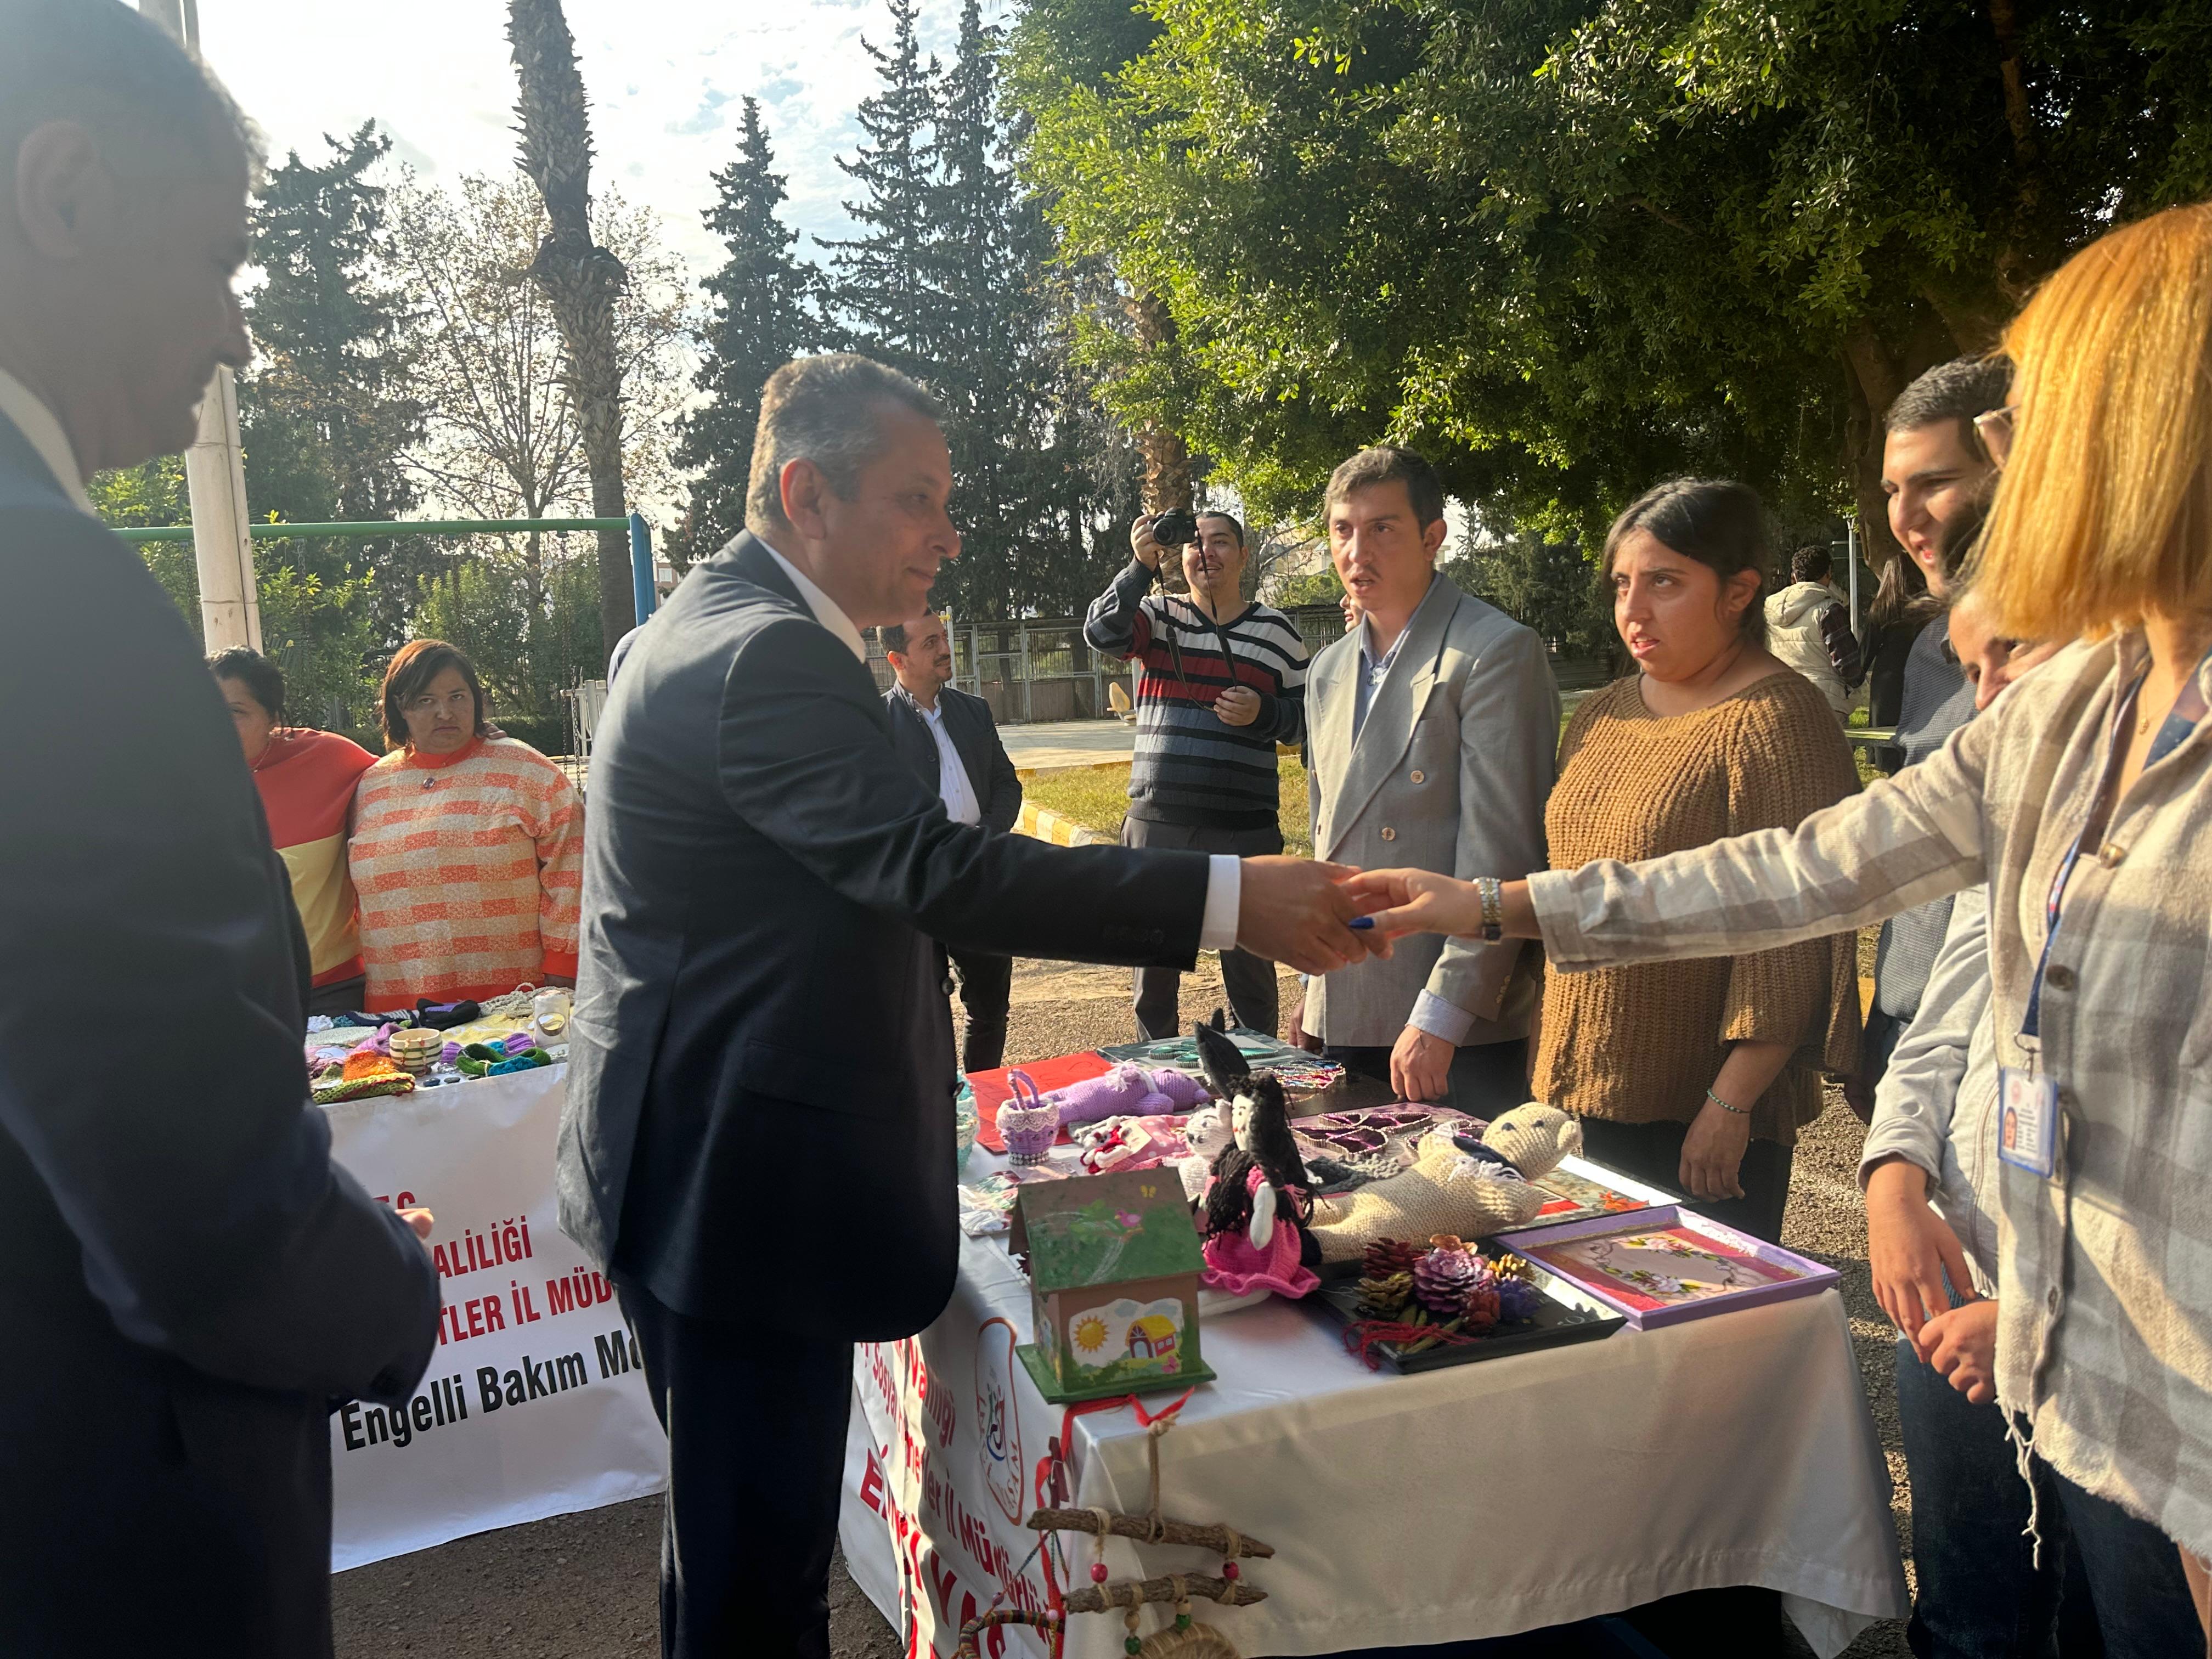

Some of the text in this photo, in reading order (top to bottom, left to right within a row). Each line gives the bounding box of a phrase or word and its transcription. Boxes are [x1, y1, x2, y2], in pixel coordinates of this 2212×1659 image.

[433, 1215, 532, 1279] ALİLİĞİ
[439, 1266, 612, 1346] TLER İL MÜD
[340, 1374, 468, 1452] Engelli
[476, 1352, 588, 1413] Bakım
